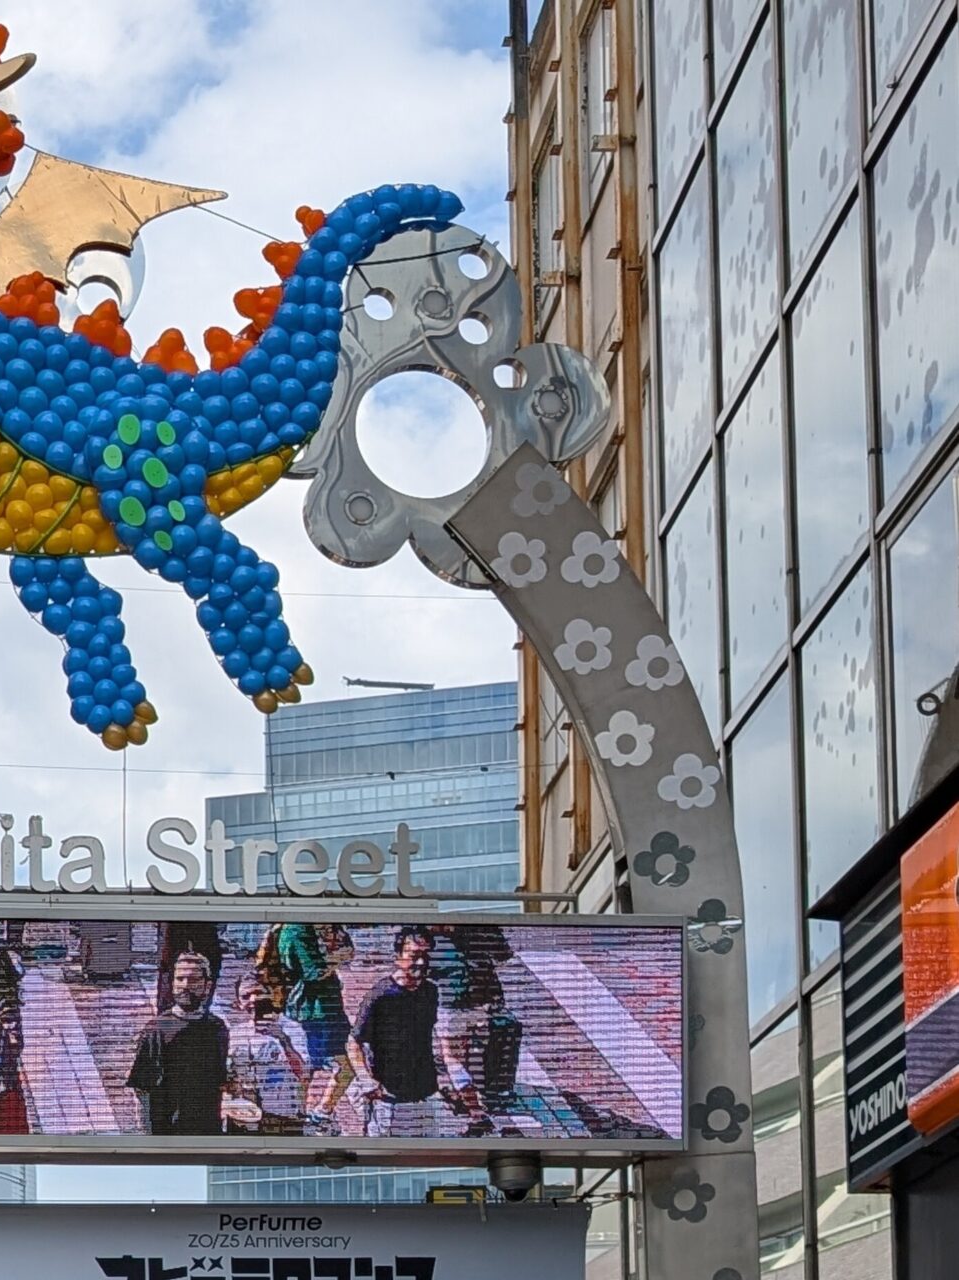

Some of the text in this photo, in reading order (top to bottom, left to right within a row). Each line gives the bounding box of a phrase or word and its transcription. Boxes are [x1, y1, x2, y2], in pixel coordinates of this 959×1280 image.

[146, 817, 424, 897] Street
[849, 1073, 908, 1141] YOSHINO
[219, 1213, 323, 1231] Perfume
[243, 1233, 351, 1250] Anniversary
